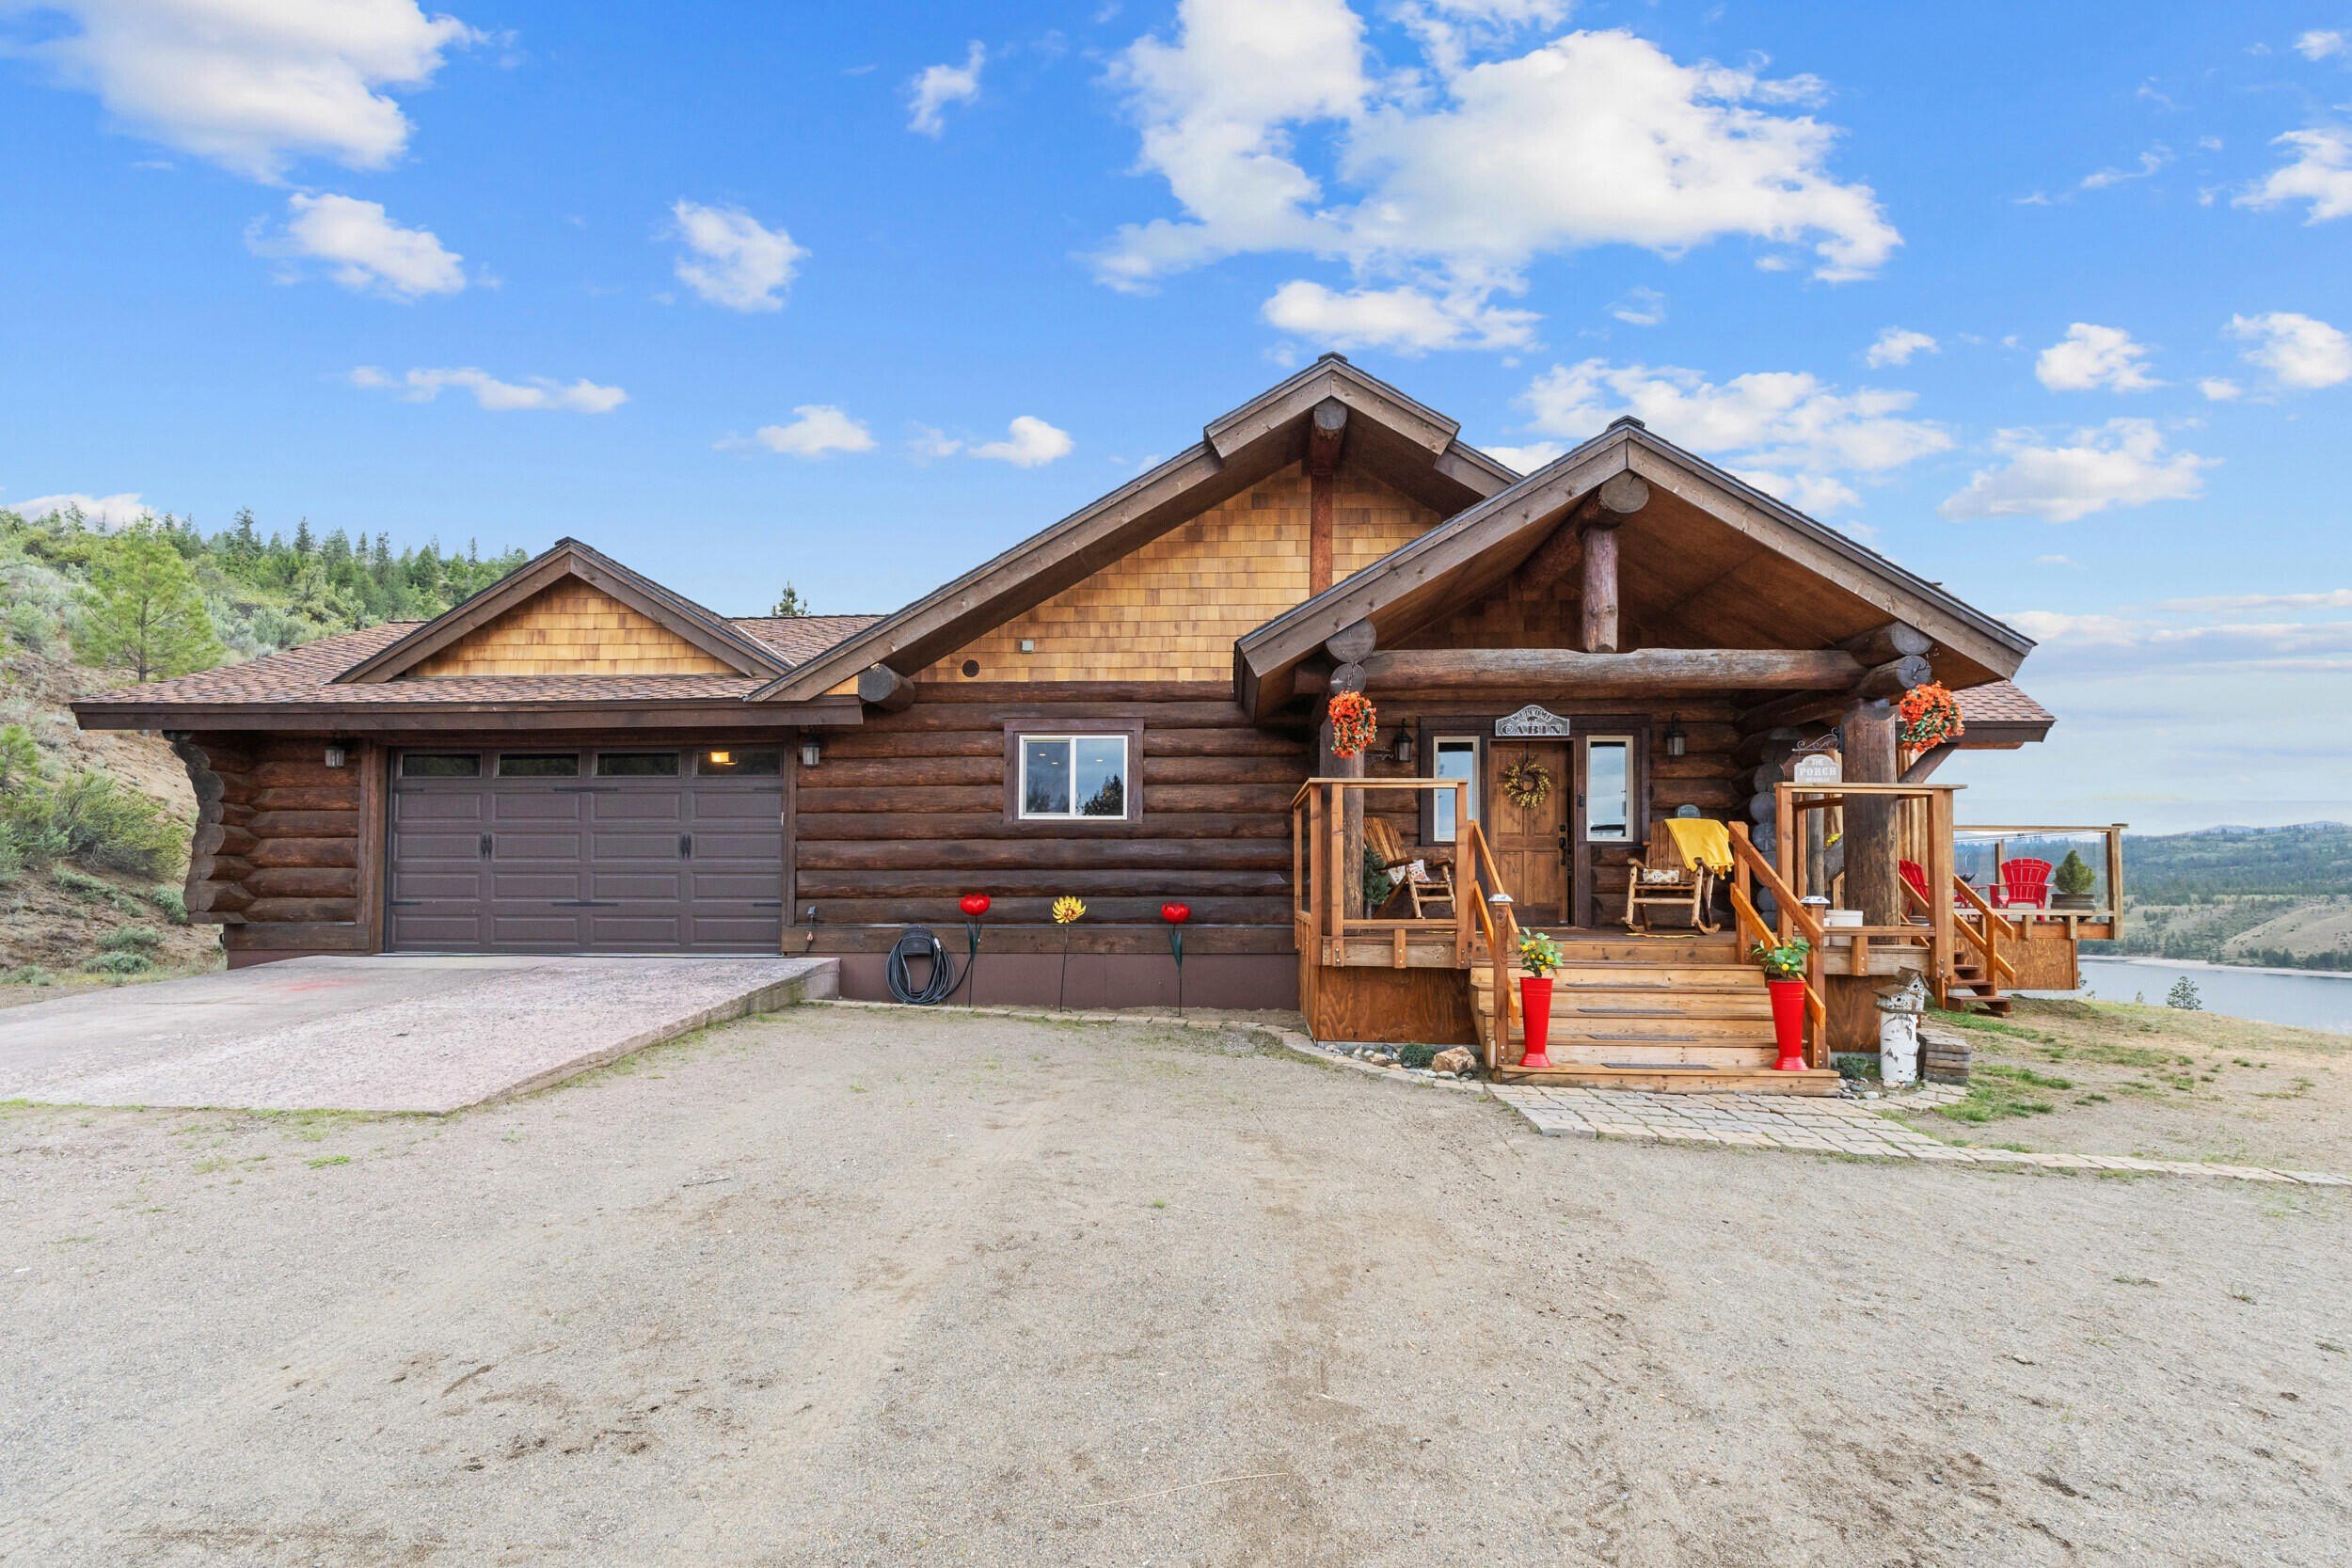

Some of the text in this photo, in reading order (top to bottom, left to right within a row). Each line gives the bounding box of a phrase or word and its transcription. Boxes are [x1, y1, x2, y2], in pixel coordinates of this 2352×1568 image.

[1512, 709, 1551, 721] WELCOME
[1502, 725, 1561, 735] CABIN
[1799, 767, 1836, 776] PORCH
